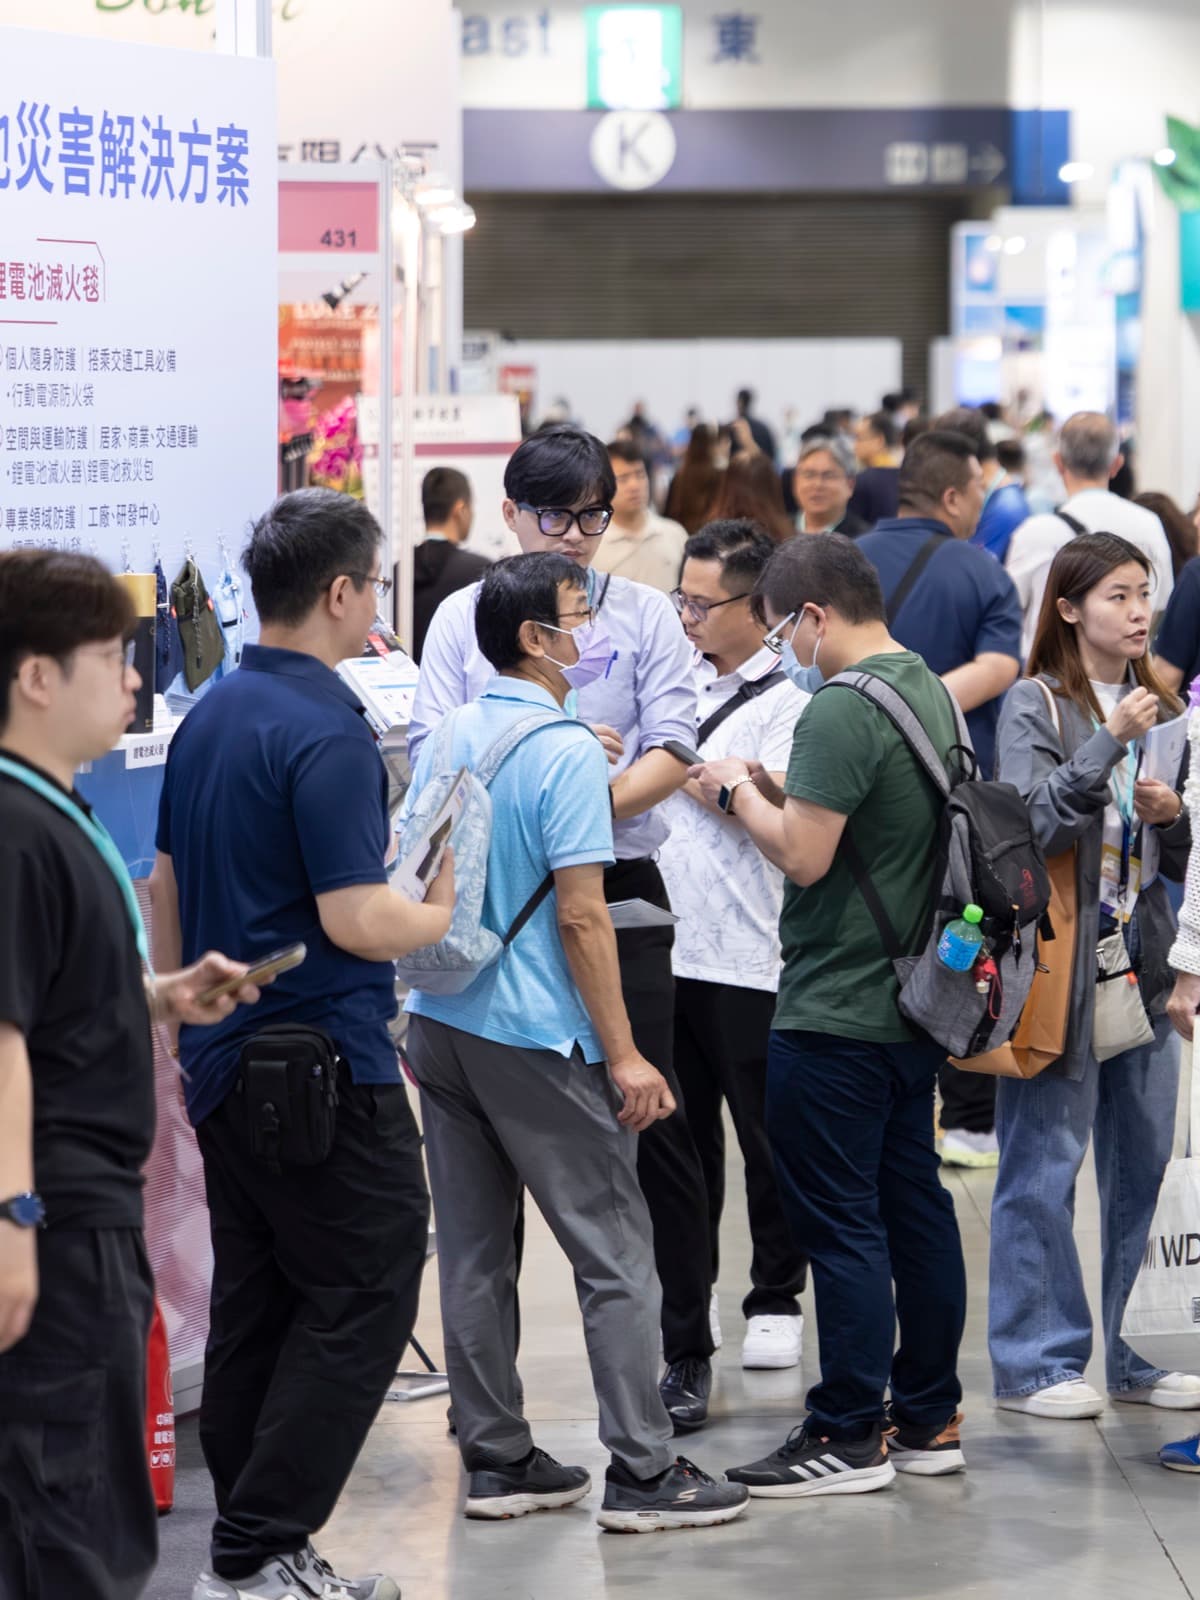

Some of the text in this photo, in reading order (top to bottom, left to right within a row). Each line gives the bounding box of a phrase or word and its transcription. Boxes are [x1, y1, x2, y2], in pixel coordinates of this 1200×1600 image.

[711, 14, 761, 63] 東
[617, 121, 655, 173] K
[320, 230, 357, 248] 431
[6, 347, 177, 372] 個人隨身防護 搭乘交通工具必備
[5, 505, 76, 532] 專業領域防護
